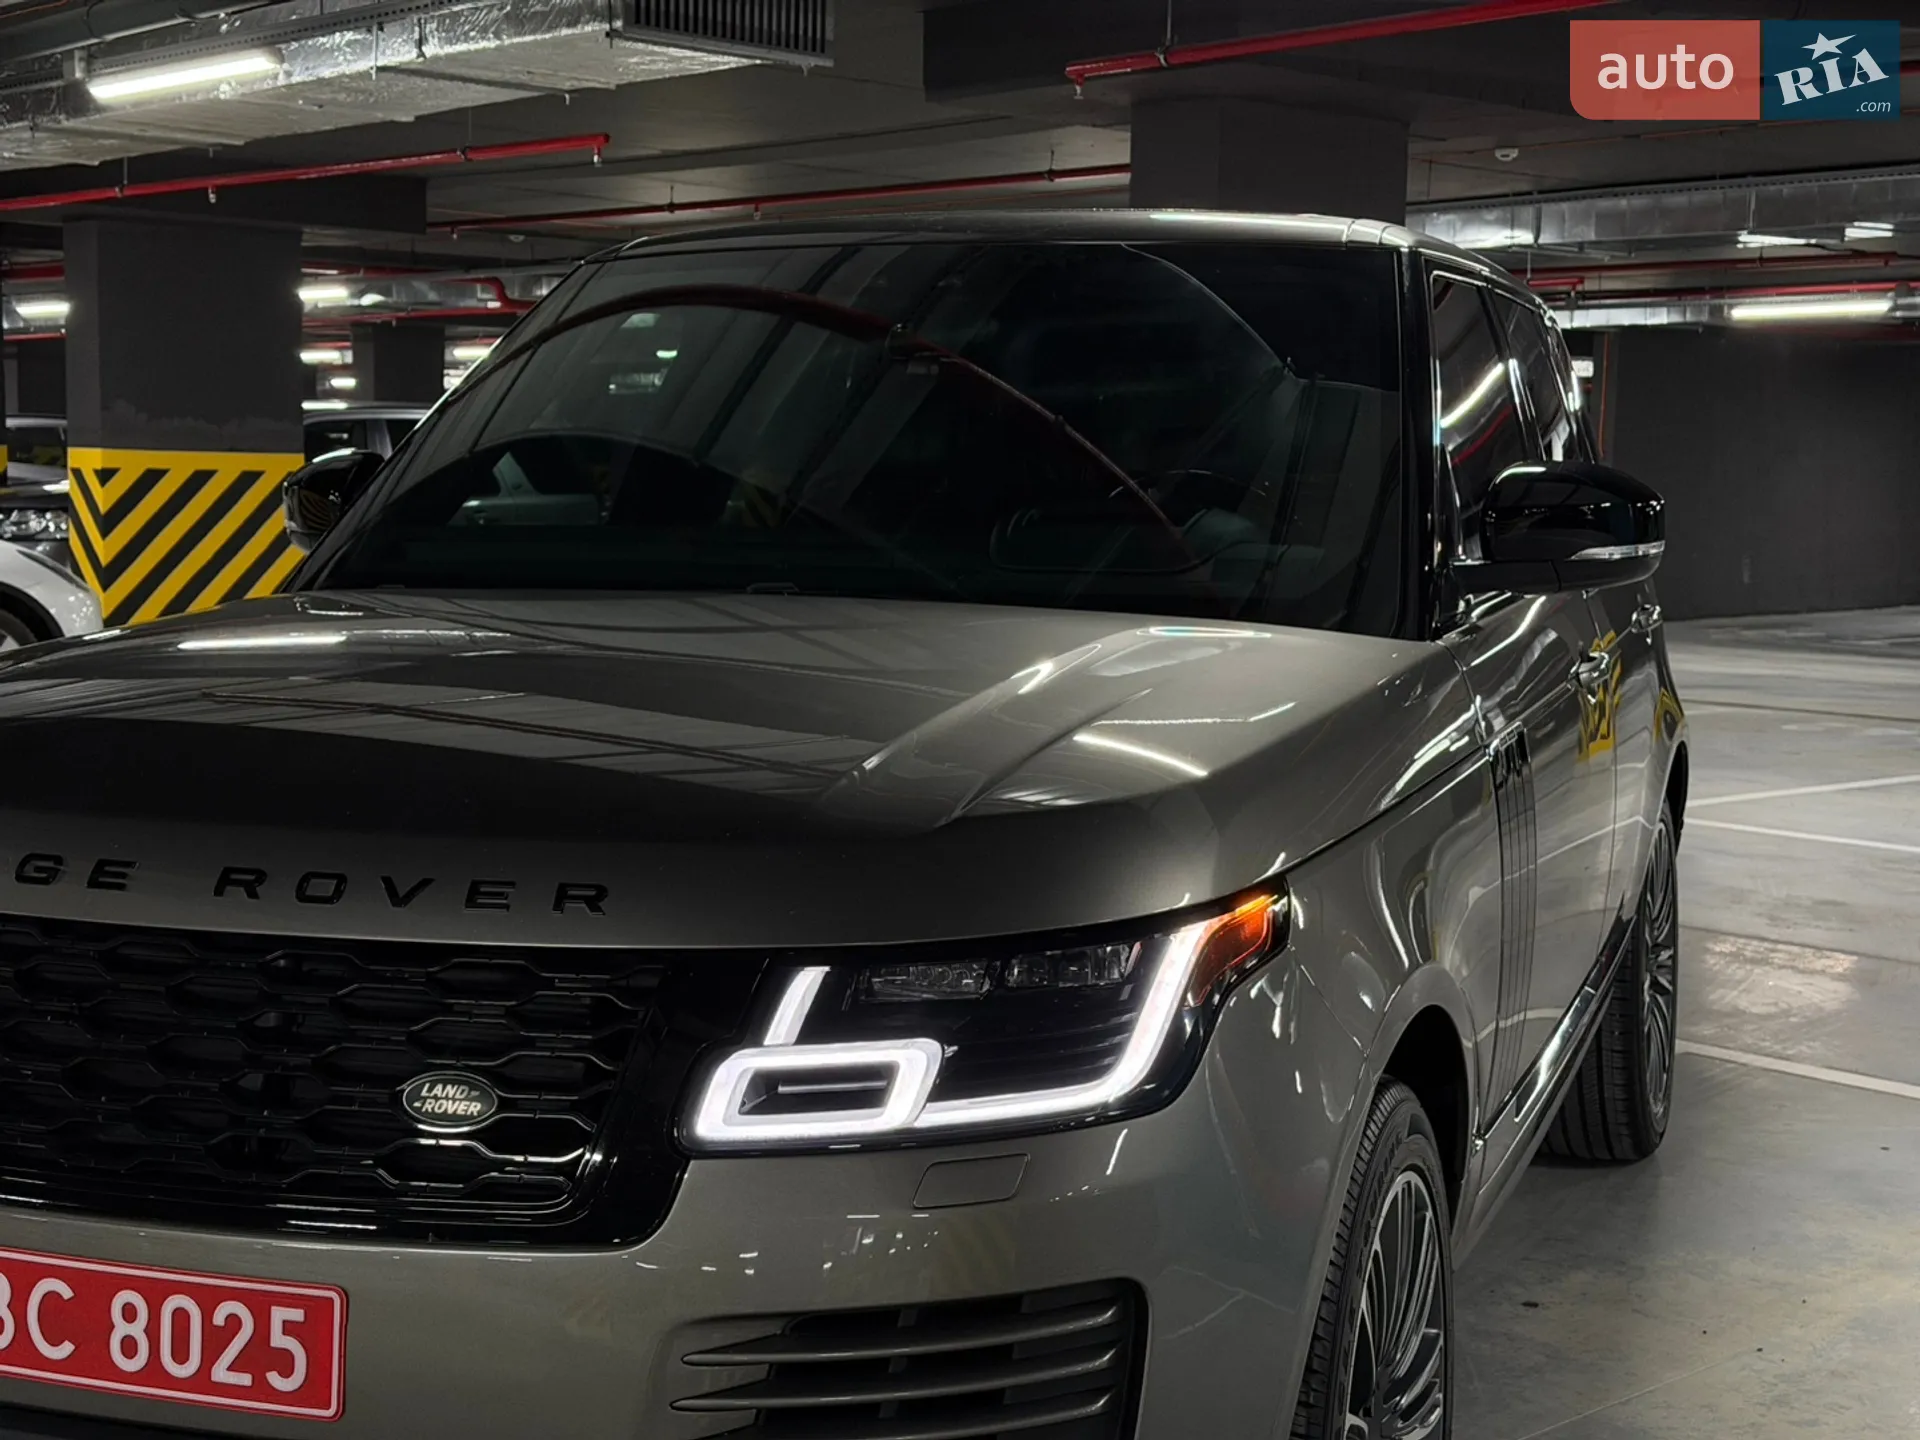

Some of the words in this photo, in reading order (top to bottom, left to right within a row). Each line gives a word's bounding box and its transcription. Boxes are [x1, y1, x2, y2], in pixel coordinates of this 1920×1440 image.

[213, 866, 609, 916] ROVER
[420, 1082, 469, 1099] LAND
[421, 1098, 482, 1116] ROVER
[109, 1289, 308, 1393] 8025
